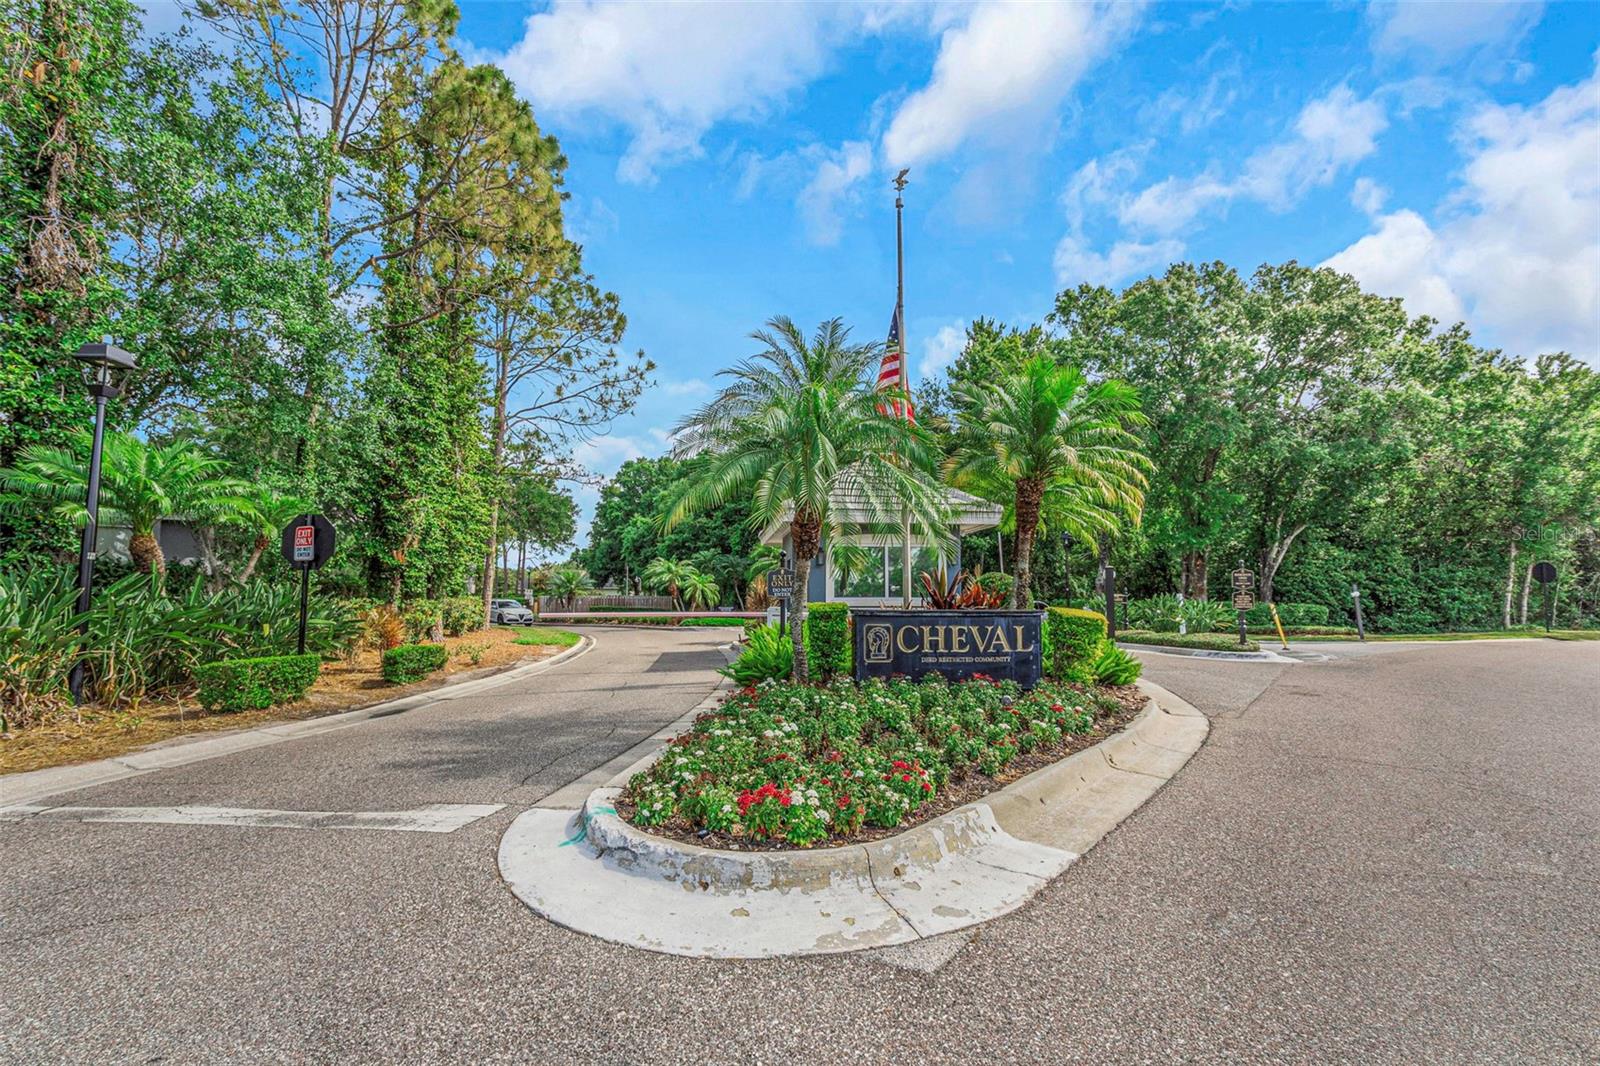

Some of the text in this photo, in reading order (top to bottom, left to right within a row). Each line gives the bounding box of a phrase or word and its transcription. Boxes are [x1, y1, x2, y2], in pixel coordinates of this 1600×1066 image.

[297, 529, 312, 537] EXIT
[296, 537, 312, 545] ONLY
[896, 624, 1034, 653] CHEVAL
